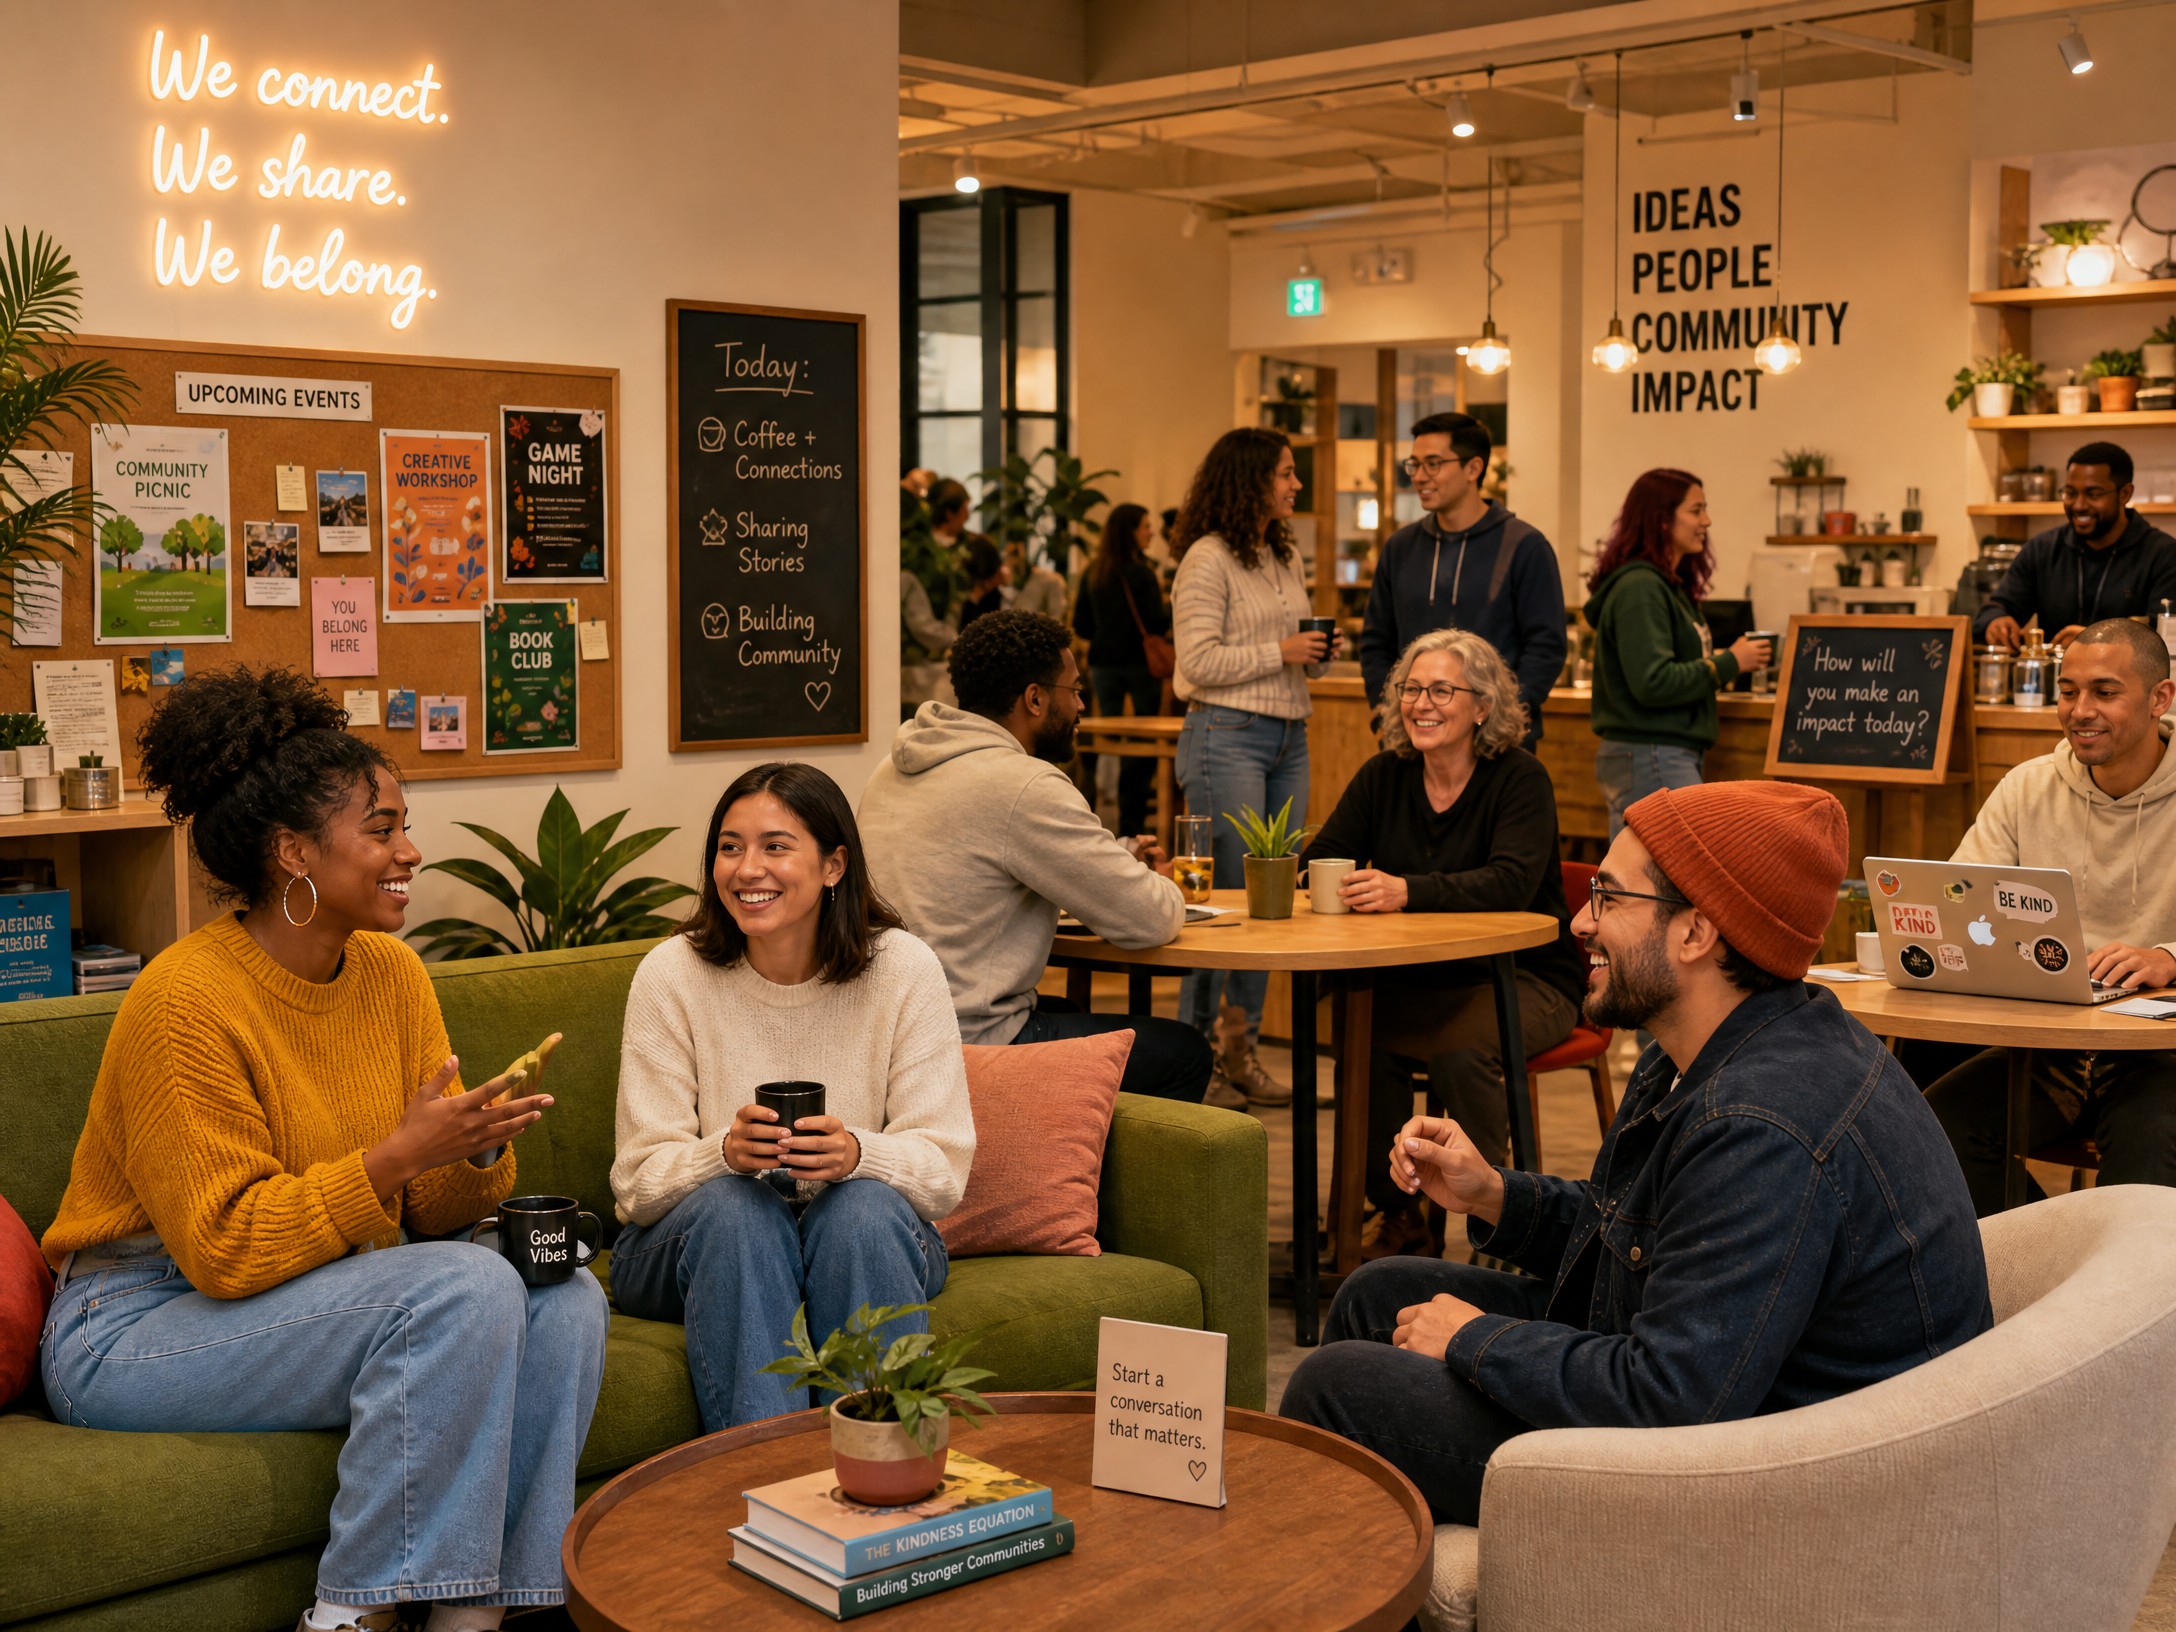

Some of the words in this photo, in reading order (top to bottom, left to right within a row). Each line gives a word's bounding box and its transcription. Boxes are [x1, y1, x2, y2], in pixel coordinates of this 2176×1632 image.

[151, 30, 237, 101] We
[257, 63, 449, 124] connect.
[153, 125, 238, 193] We
[258, 133, 406, 206] share.
[1633, 183, 1741, 234] IDEAS
[155, 217, 240, 286] We
[262, 223, 437, 329] belong.
[1633, 243, 1772, 295] PEOPLE
[715, 342, 809, 397] Today:
[189, 383, 287, 406] UPCOMING
[294, 389, 360, 410] EVENTS
[1632, 368, 1763, 414] IMPACT
[734, 420, 797, 449] Coffee
[402, 453, 471, 469] CREATIVE
[528, 442, 582, 463] GAME
[116, 460, 208, 479] COMMUNITY
[528, 465, 584, 485] NIGHT
[736, 454, 843, 480] Connections
[135, 482, 191, 499] PICNIC
[395, 473, 478, 488] WORKSHOP
[736, 511, 808, 549] Sharing
[739, 547, 805, 573] Stories
[332, 600, 356, 614] YOU
[322, 619, 367, 633] BELONG
[739, 604, 815, 642] Building
[331, 639, 360, 653] HERE
[509, 632, 554, 649] BOOK
[511, 652, 552, 669] CLUB
[739, 639, 841, 675] Community
[1814, 646, 1853, 672] How
[1862, 648, 1896, 673] will
[1805, 687, 1836, 710] you
[1845, 680, 1889, 702] make
[1897, 689, 1919, 703] an
[1797, 711, 1856, 741] impact
[1864, 710, 1929, 746] today?
[1999, 890, 2016, 908] BE
[2020, 895, 2053, 913] KIND
[1895, 918, 1935, 934] KIND
[530, 1226, 566, 1245] Good
[530, 1248, 568, 1263] Vibes
[1112, 1362, 1150, 1385] Start
[1155, 1374, 1164, 1388] a
[1110, 1395, 1202, 1421] conversation
[1109, 1418, 1139, 1439] that
[1144, 1428, 1206, 1450] matters.
[865, 1543, 891, 1561] THE
[896, 1522, 964, 1553] KINDNESS
[969, 1504, 1035, 1534] EQUATION
[857, 1577, 908, 1603] Building
[911, 1560, 964, 1587] Stronger
[967, 1537, 1045, 1569] Communities
